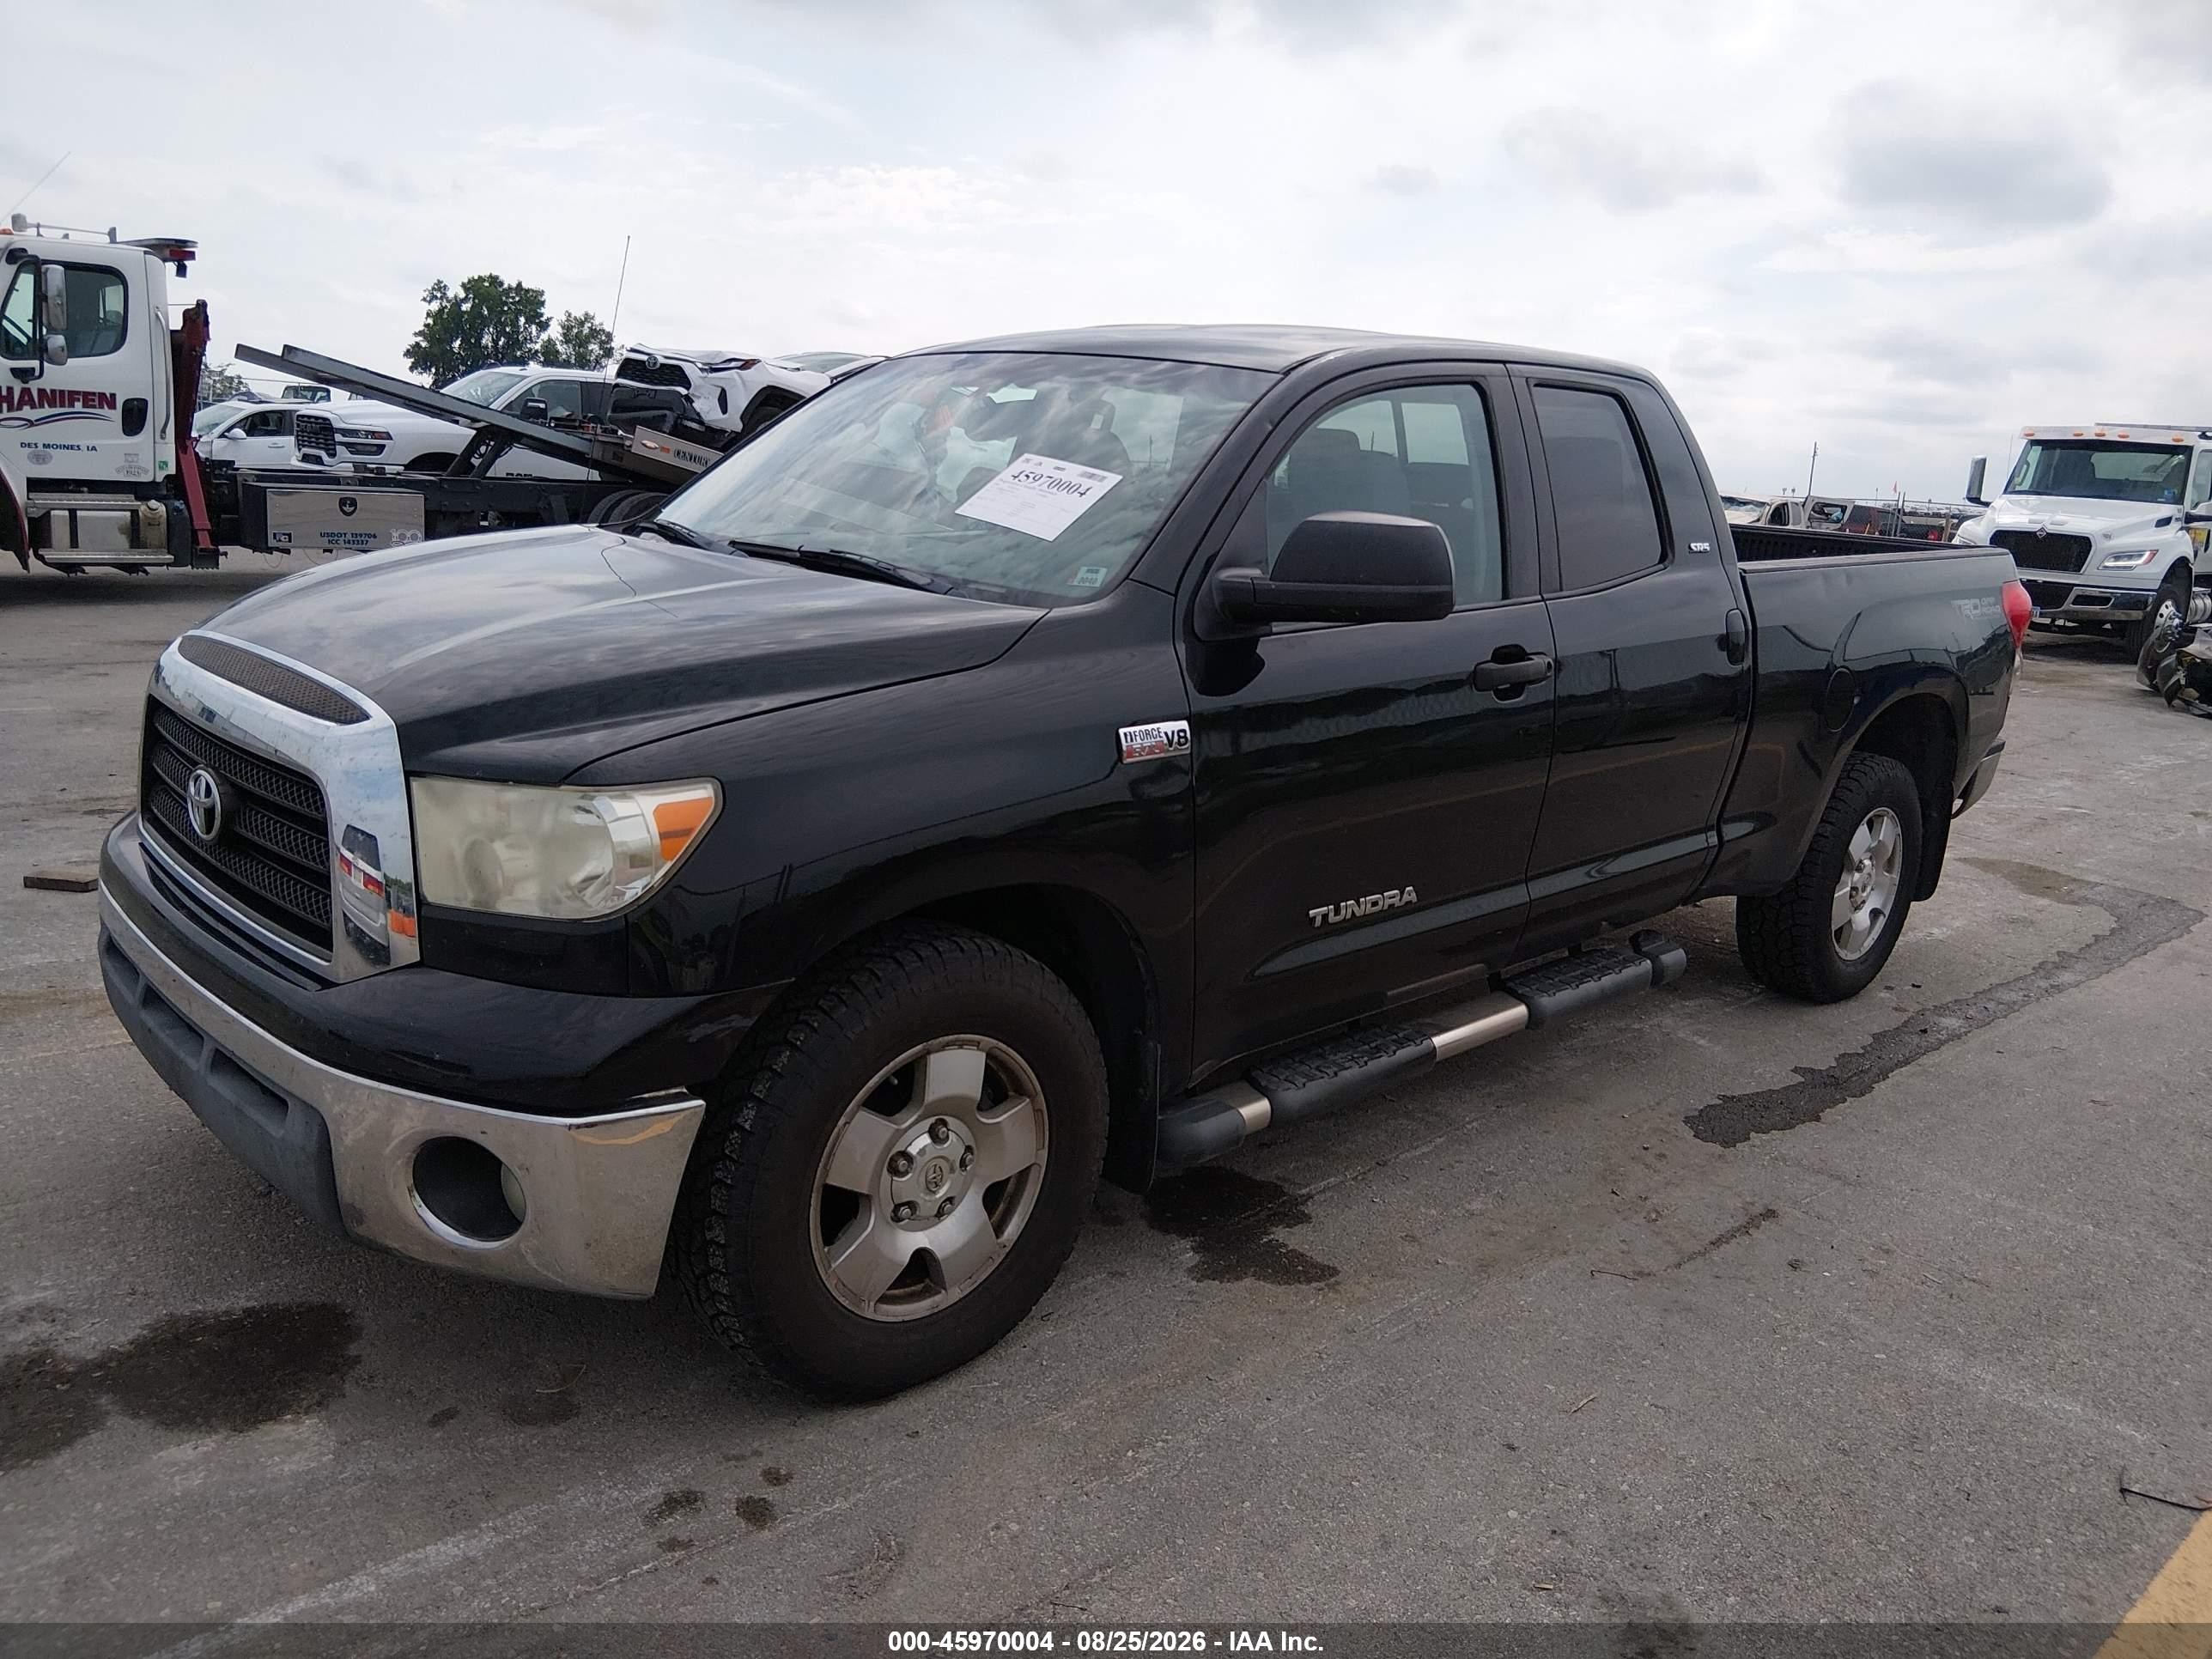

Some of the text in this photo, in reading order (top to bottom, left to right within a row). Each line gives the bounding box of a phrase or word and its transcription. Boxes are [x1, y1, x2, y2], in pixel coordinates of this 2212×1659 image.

[0, 386, 118, 412] HANIFEN
[1012, 470, 1093, 498] 45970004
[1164, 728, 1189, 750] V8
[1309, 885, 1418, 927] TUNDRA
